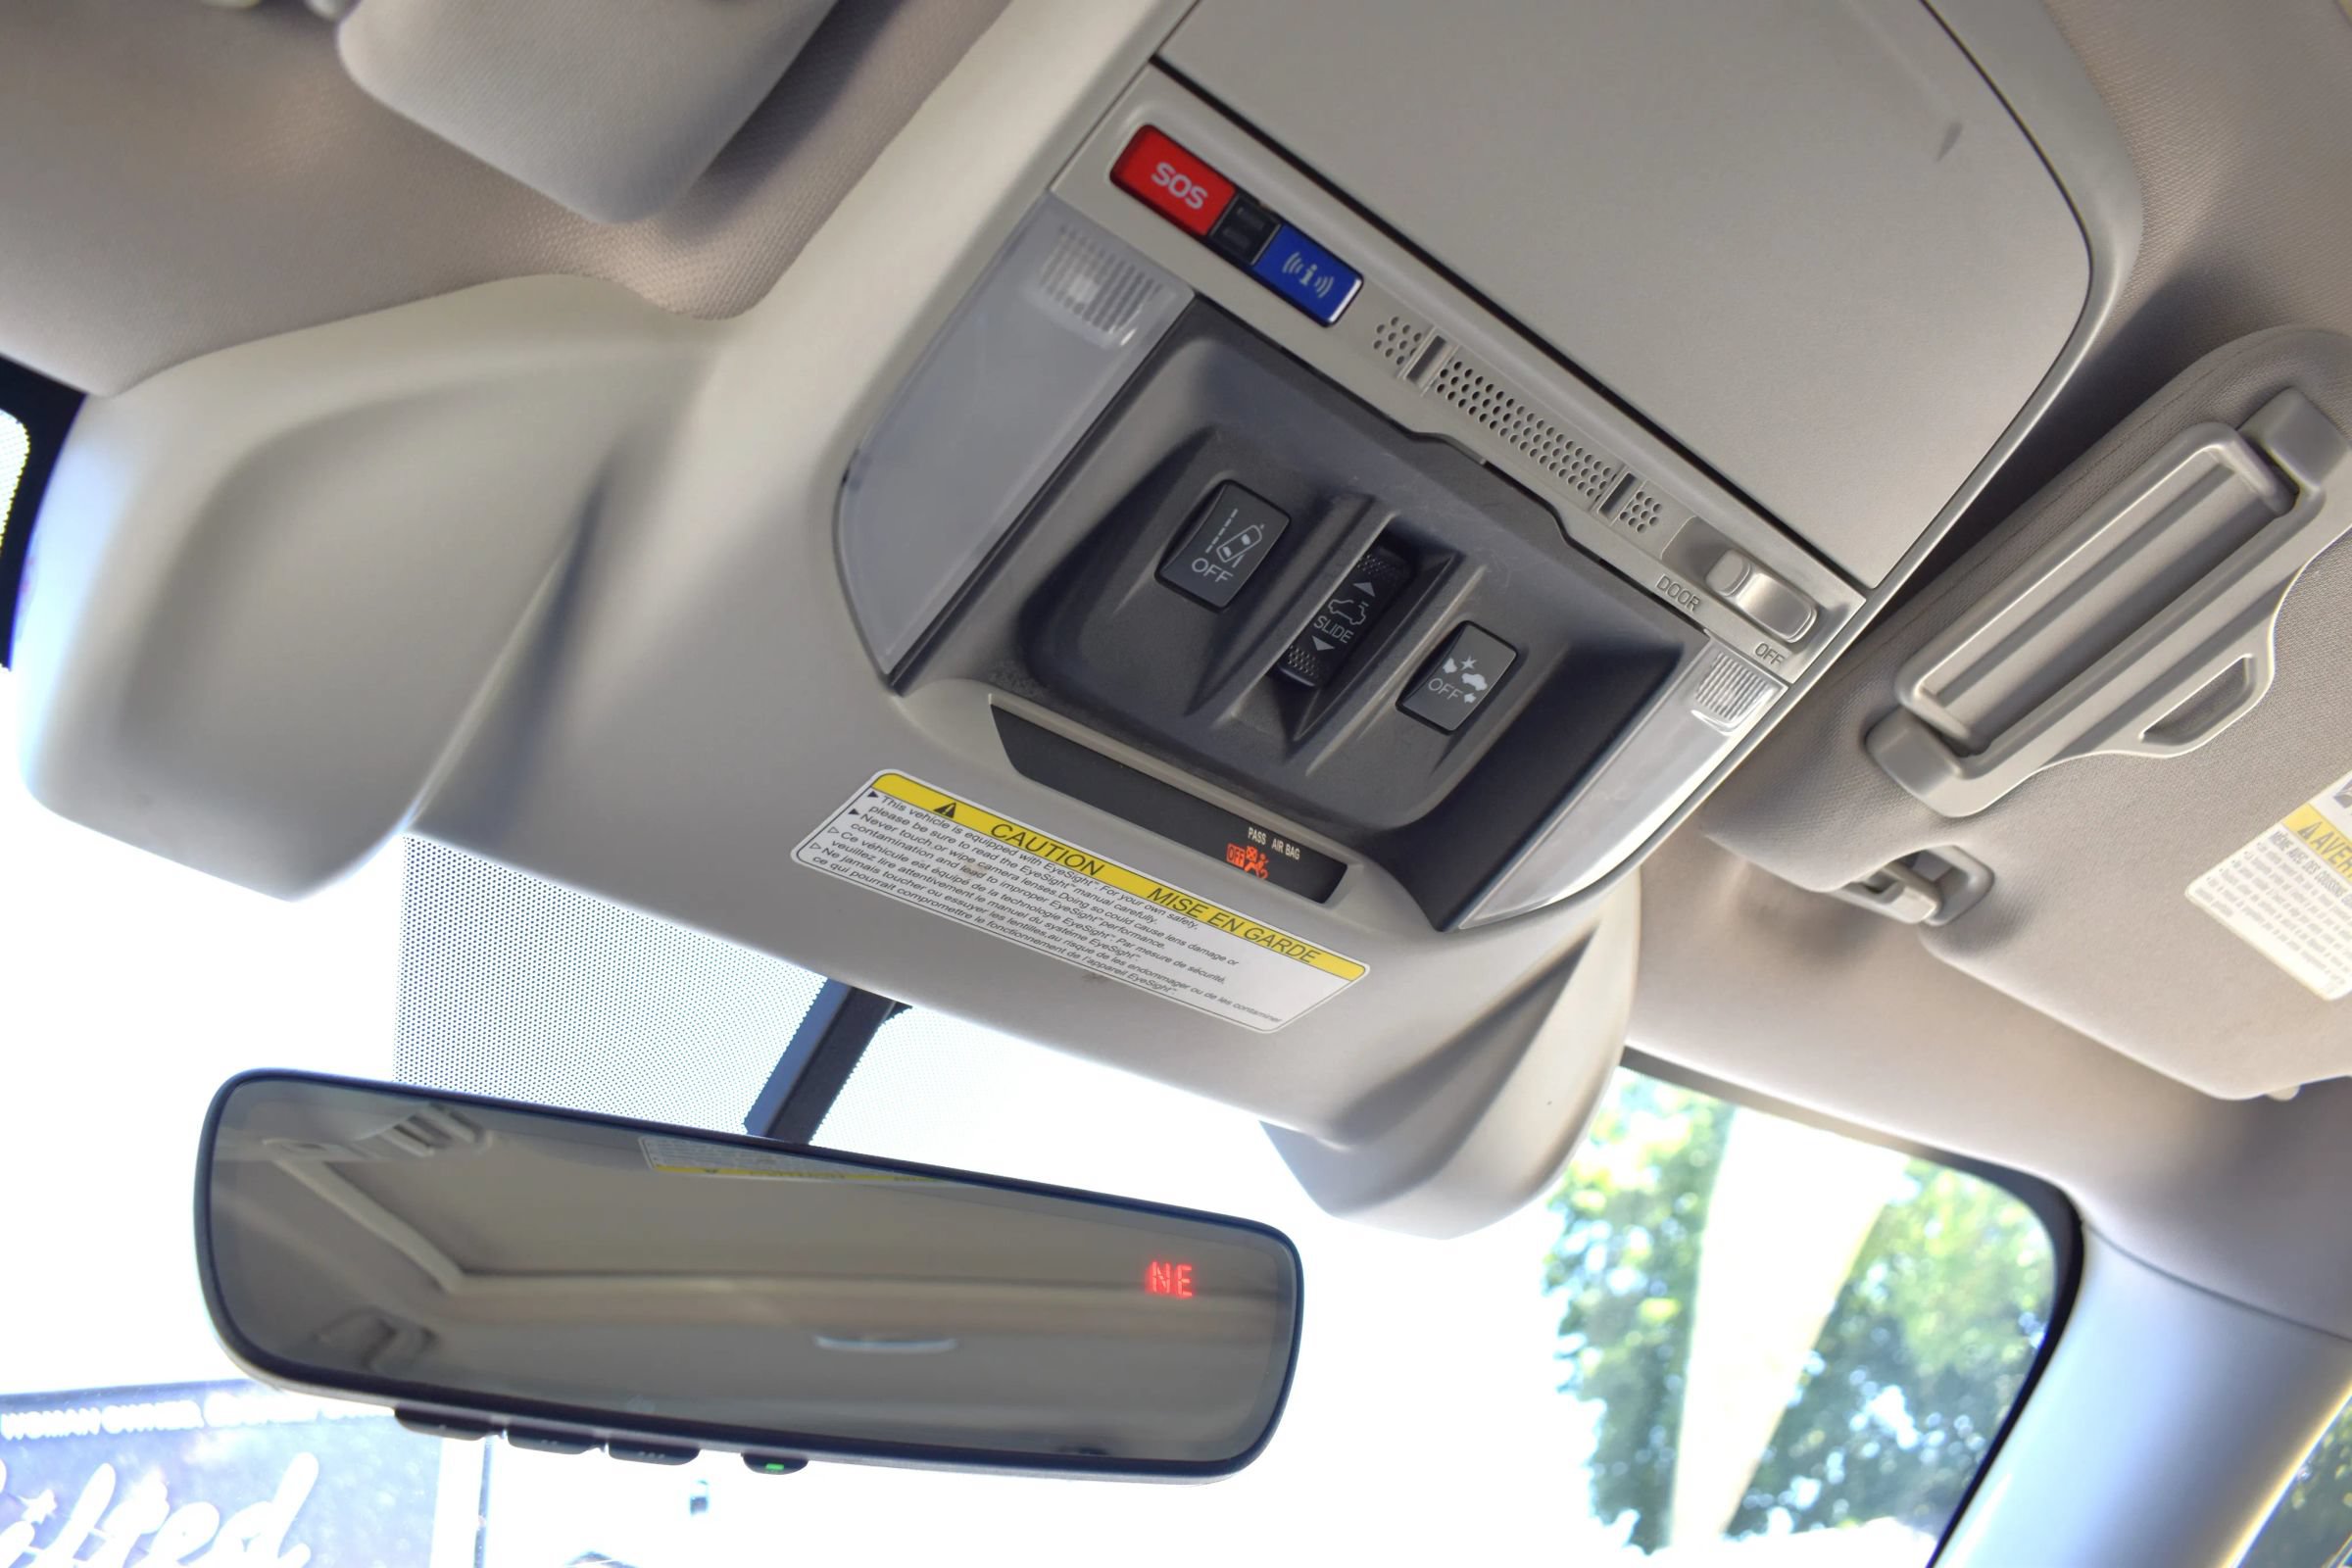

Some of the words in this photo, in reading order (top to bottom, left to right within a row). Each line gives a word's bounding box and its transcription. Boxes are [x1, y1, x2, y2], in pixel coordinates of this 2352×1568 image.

[1151, 162, 1208, 209] SOS
[1192, 558, 1234, 582] OFF
[1656, 575, 1701, 612] DOOR
[1313, 614, 1354, 644] SLIDE
[1755, 642, 1786, 666] OFF
[1428, 677, 1462, 700] OFF
[850, 822, 934, 858] contamination
[935, 857, 960, 868] and
[958, 864, 987, 878] lead
[999, 880, 1050, 903] improper
[867, 806, 909, 825] please
[910, 821, 928, 832] be
[929, 830, 956, 843] sure
[957, 840, 970, 849] to
[970, 847, 1000, 860] read
[999, 857, 1018, 868] the
[1072, 887, 1114, 906] manual
[881, 795, 906, 811] This
[908, 808, 950, 828] vehicle
[951, 825, 963, 834] is
[963, 832, 1019, 856] equipped
[1018, 854, 1042, 865] with
[1099, 885, 1120, 896] For
[1116, 894, 1144, 906] your
[1144, 904, 1166, 915] own
[1227, 844, 1246, 867] OFF
[1248, 826, 1267, 845] PASS
[1271, 838, 1284, 854] AIR
[1285, 844, 1300, 860] BAG
[811, 856, 828, 864] ce
[829, 862, 851, 872] qui
[848, 870, 896, 890] pourrait
[896, 888, 972, 918] compromettre
[986, 920, 1066, 954] fonctionnement
[831, 840, 876, 861] veuillez
[876, 857, 896, 868] lire
[897, 866, 975, 898] attentivement
[973, 894, 986, 903] le
[986, 901, 1029, 918] manuel
[840, 831, 858, 842] Ce
[861, 840, 909, 861] véhicule
[910, 860, 930, 870] est
[930, 866, 970, 885] équipé
[970, 883, 986, 892] de
[987, 888, 999, 897] la
[1000, 893, 1061, 920] technologie
[1114, 937, 1135, 948] Par
[1134, 946, 1172, 962] mesure
[859, 812, 898, 832] Never
[899, 828, 932, 846] touch
[948, 849, 975, 863] wipe
[976, 861, 1019, 880] camera
[1103, 910, 1135, 924] could
[1133, 922, 1164, 937] cause
[1164, 934, 1187, 946] lens
[1187, 944, 1226, 961] damage
[985, 823, 1104, 876] CAUTION
[1146, 887, 1209, 917] MISE
[1206, 911, 1245, 932] EN
[1239, 927, 1321, 963] GARDE
[820, 847, 840, 858] Ne
[838, 855, 880, 873] jamais
[882, 870, 927, 890] toucher
[926, 888, 943, 897] ou
[943, 895, 988, 913] essuyer
[988, 910, 1005, 920] les
[1062, 939, 1095, 954] risque
[1109, 956, 1127, 965] les
[1216, 996, 1232, 1004] les
[1151, 1260, 1194, 1298] NE
